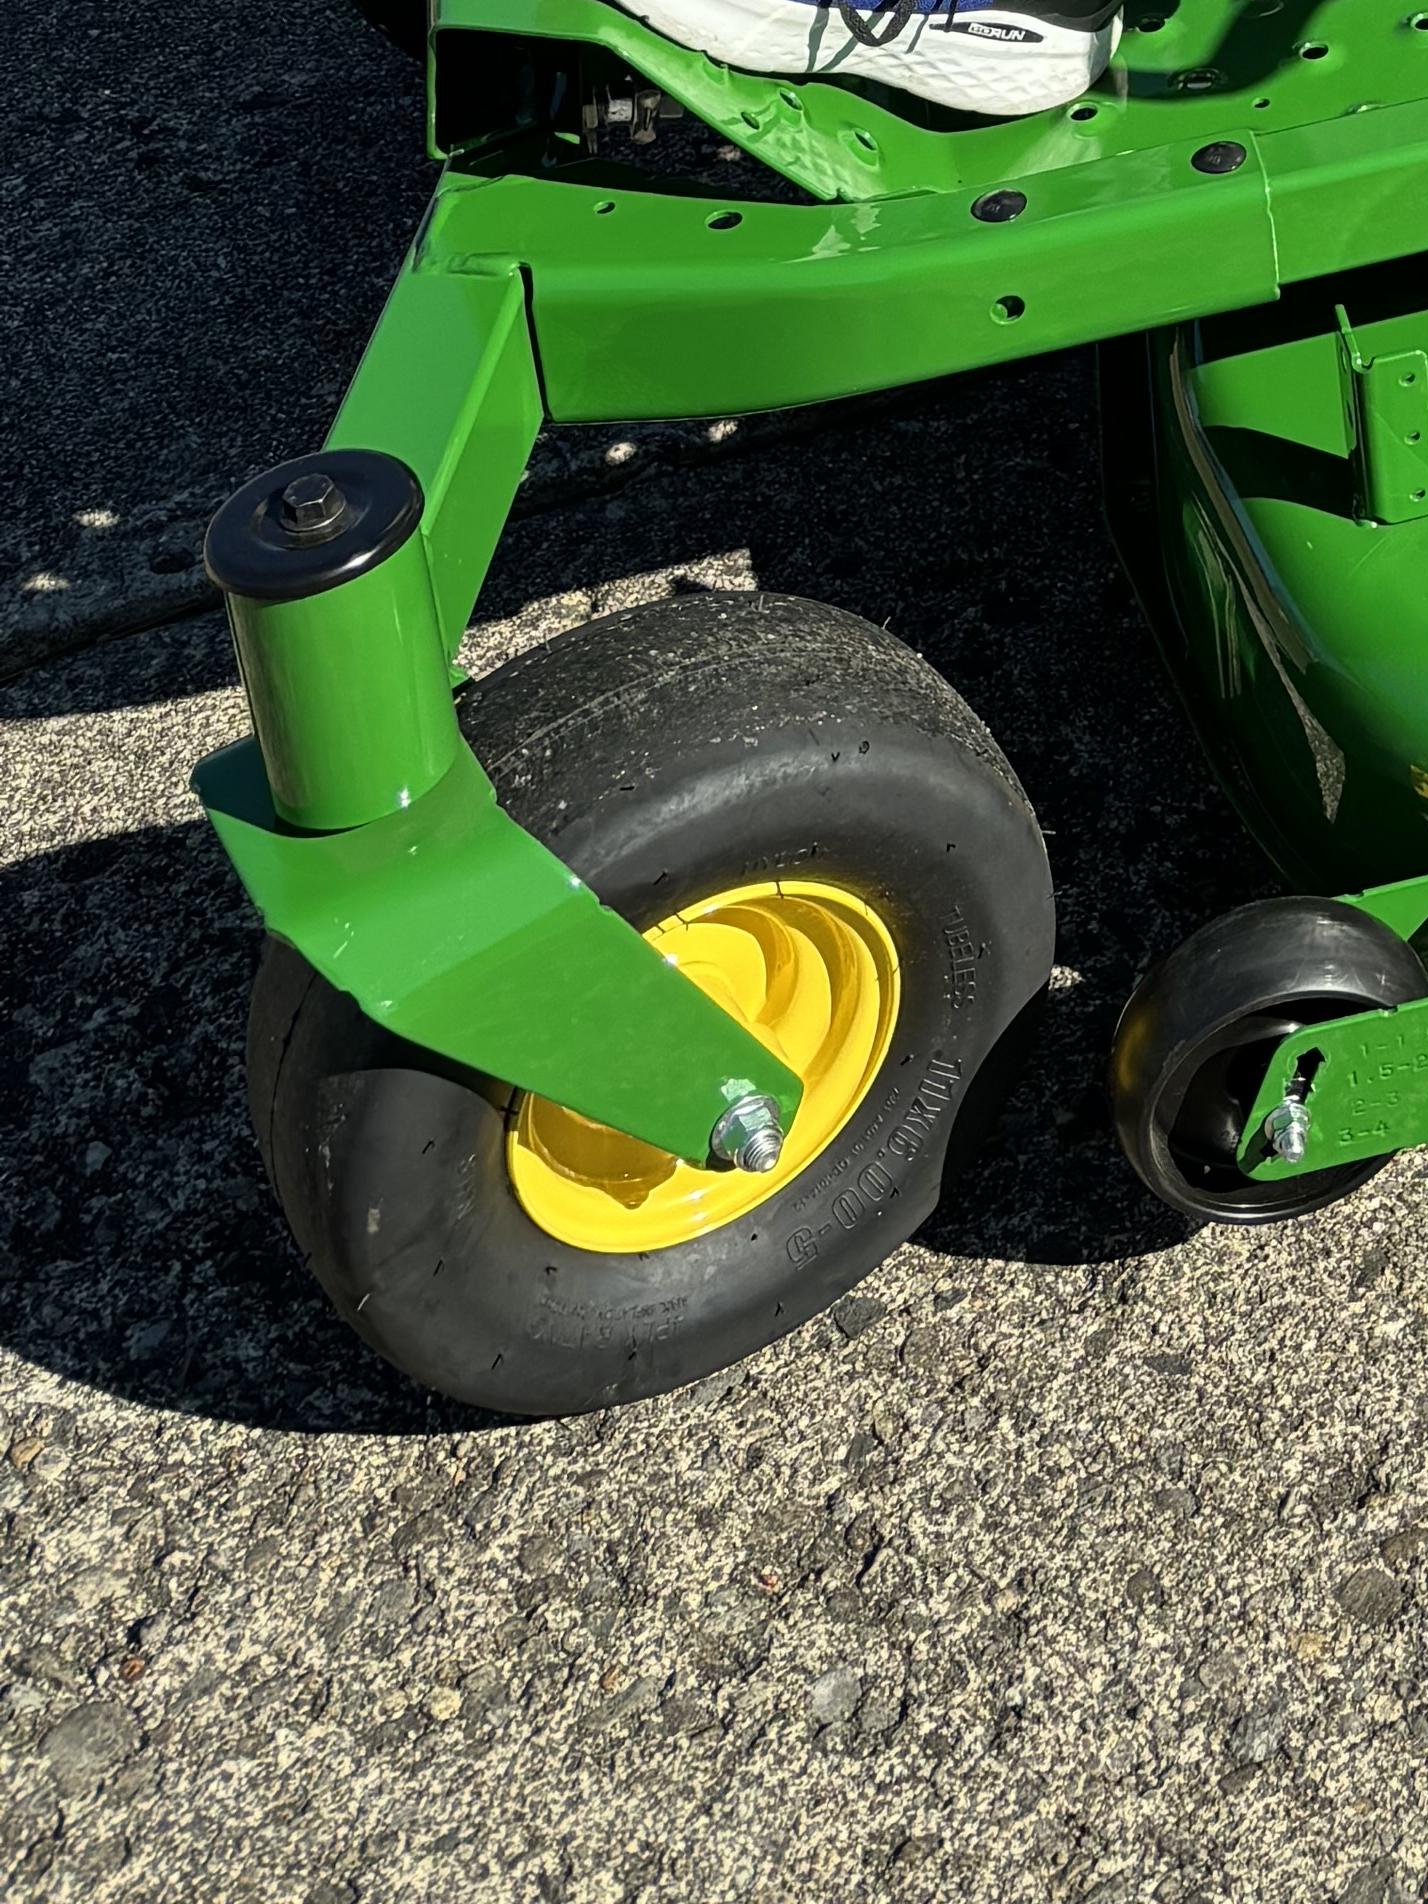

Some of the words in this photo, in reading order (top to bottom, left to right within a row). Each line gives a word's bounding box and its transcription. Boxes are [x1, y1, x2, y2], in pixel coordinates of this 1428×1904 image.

[1346, 1053, 1428, 1088] 1.5-2
[1351, 1090, 1400, 1117] 2-3
[1337, 1119, 1392, 1146] 3-4
